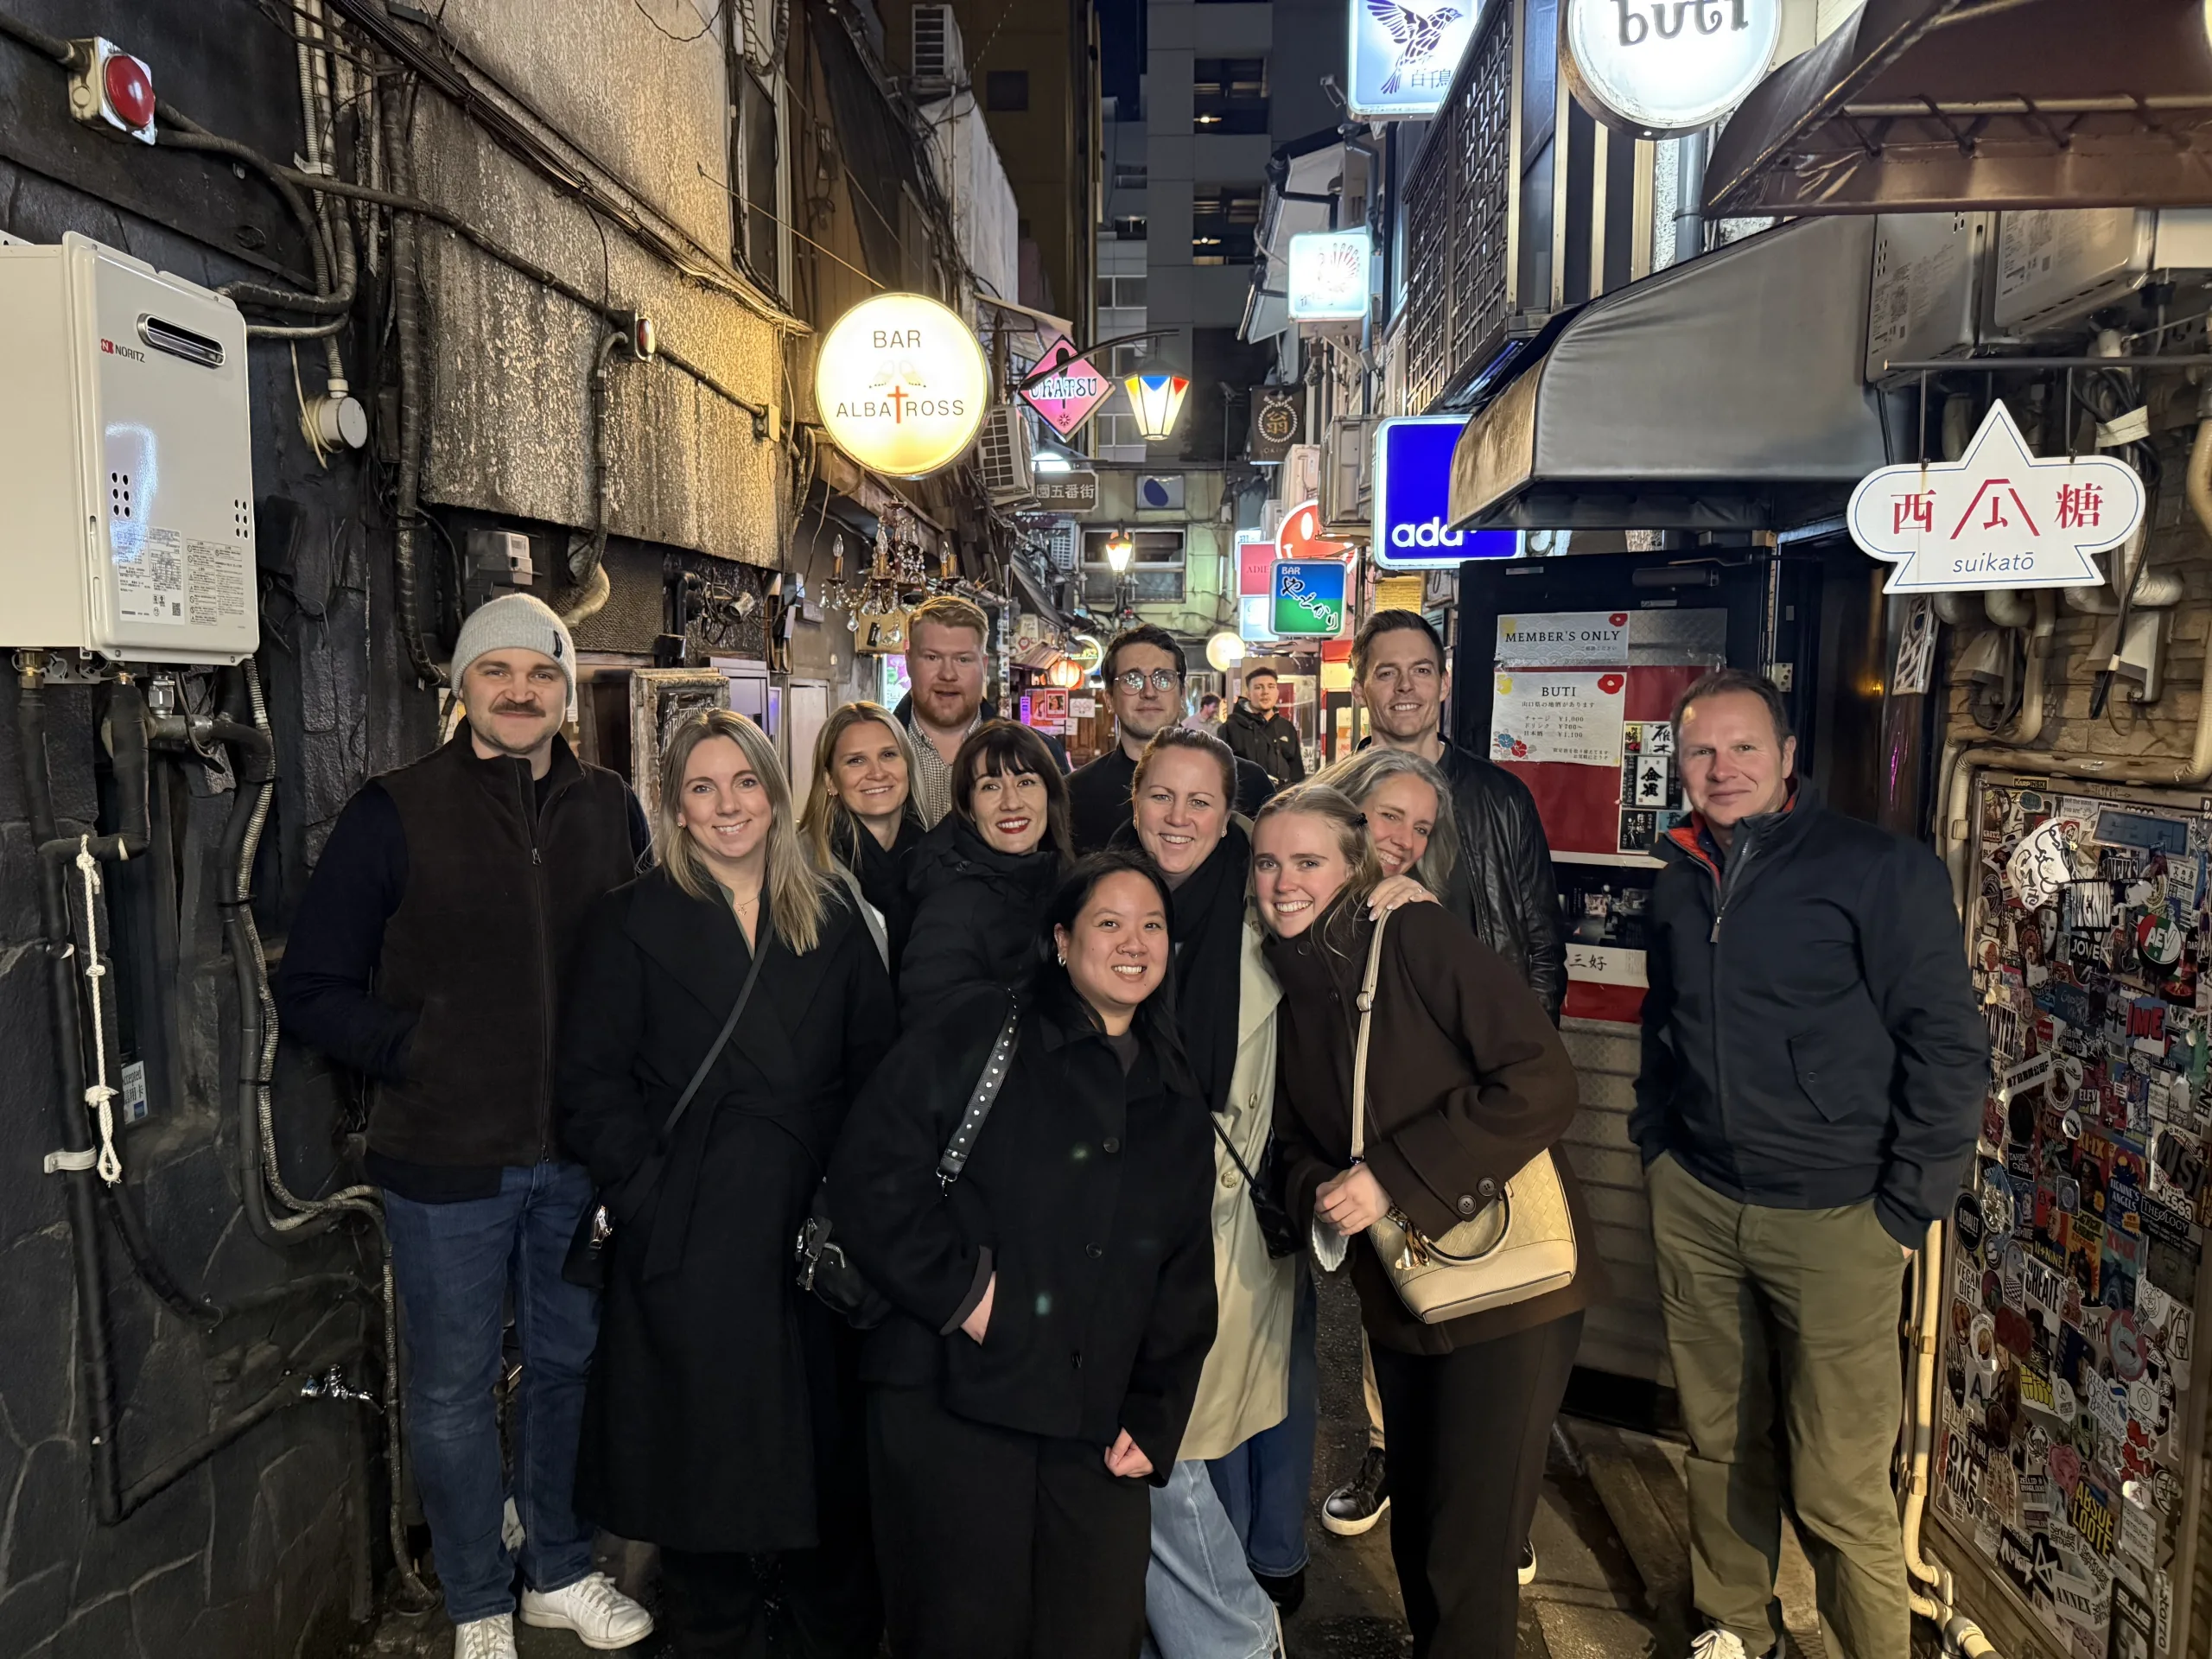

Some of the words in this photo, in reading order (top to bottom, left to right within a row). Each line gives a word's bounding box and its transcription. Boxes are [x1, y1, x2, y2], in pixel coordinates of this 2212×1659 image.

[873, 329, 922, 349] BAR
[115, 344, 145, 363] NORITZ
[1037, 484, 1096, 499] 園五番街
[1247, 565, 1269, 574] ADIE
[1281, 566, 1300, 575] BAR
[1953, 551, 2034, 574] suikatō
[1505, 631, 1576, 642] MEMBER'S
[1580, 631, 1620, 641] ONLY
[1541, 686, 1577, 696] BUTI
[2144, 924, 2179, 951] AEV
[1569, 954, 1607, 971] 三好
[124, 1065, 142, 1086] ccepted
[1957, 1262, 1980, 1290] VEGAN
[1959, 1281, 1976, 1303] DIET
